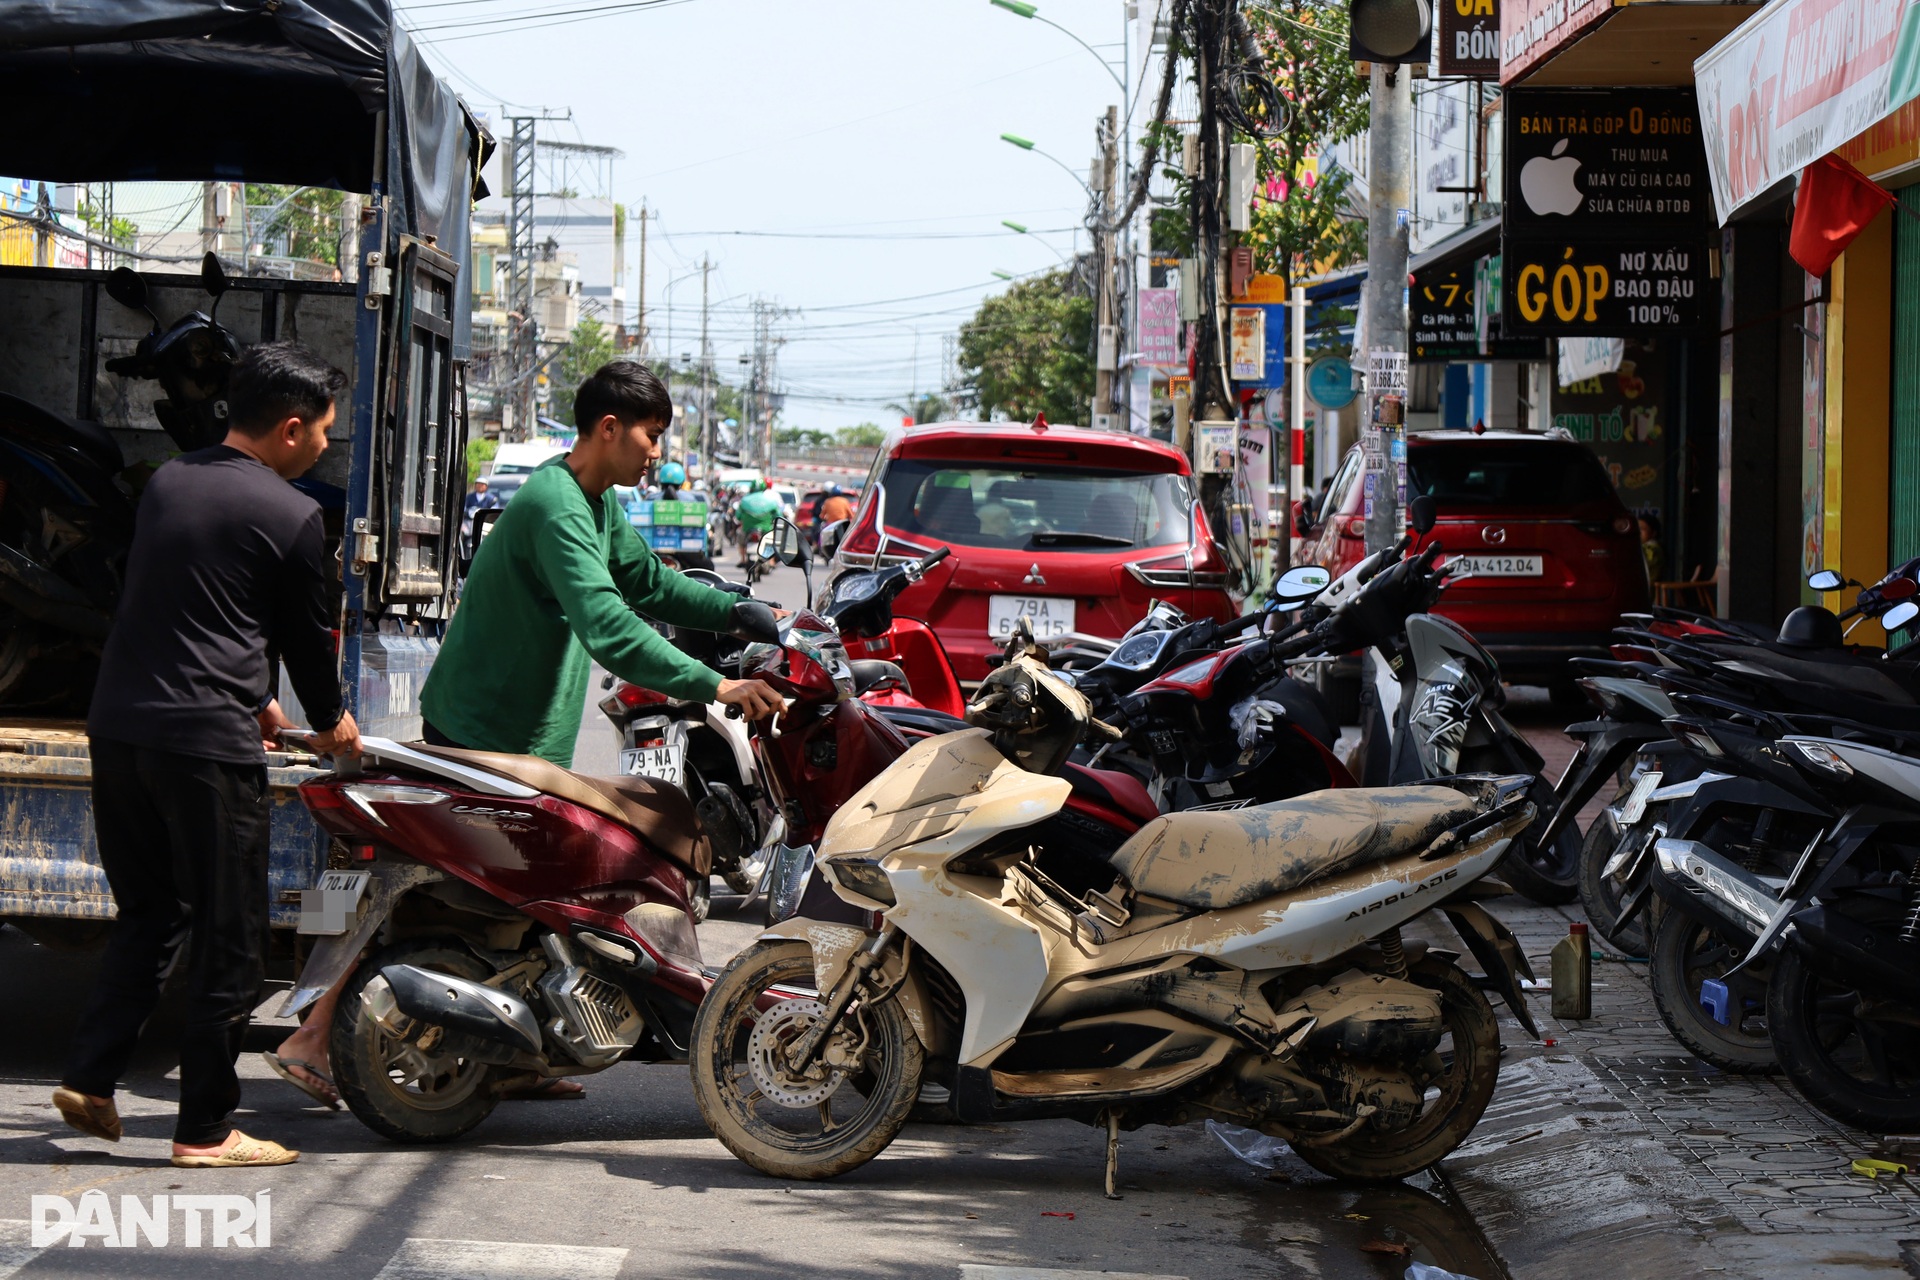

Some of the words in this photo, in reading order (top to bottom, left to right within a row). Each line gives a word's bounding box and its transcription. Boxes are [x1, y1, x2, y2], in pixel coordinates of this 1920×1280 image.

[1520, 112, 1553, 134] BÁN
[1558, 110, 1588, 134] TRẢ
[1593, 113, 1624, 134] GÓP
[1649, 110, 1692, 134] ĐỒNG
[1612, 148, 1636, 162] THU
[1640, 148, 1668, 162] MUA
[1588, 169, 1616, 186] MÁY
[1620, 169, 1636, 186] CŨ
[1640, 169, 1662, 186] GIÁ
[1666, 173, 1691, 186] CAO
[1588, 194, 1614, 212] SỬA
[1617, 195, 1651, 212] CHỮA
[1656, 199, 1690, 212] ĐTDĐ
[1620, 251, 1646, 275] NỢ
[1652, 247, 1688, 271] XẤU
[1517, 247, 1609, 322] GÓP
[1614, 280, 1650, 298] BAO
[1656, 276, 1694, 302] ĐẬU
[1437, 313, 1455, 324] Phê
[1628, 305, 1679, 324] 100%
[1415, 331, 1437, 342] Sinh
[1384, 357, 1398, 370] VAY
[1015, 600, 1049, 617] 79A
[628, 748, 671, 770] 79-NA
[451, 806, 533, 819] LEAD
